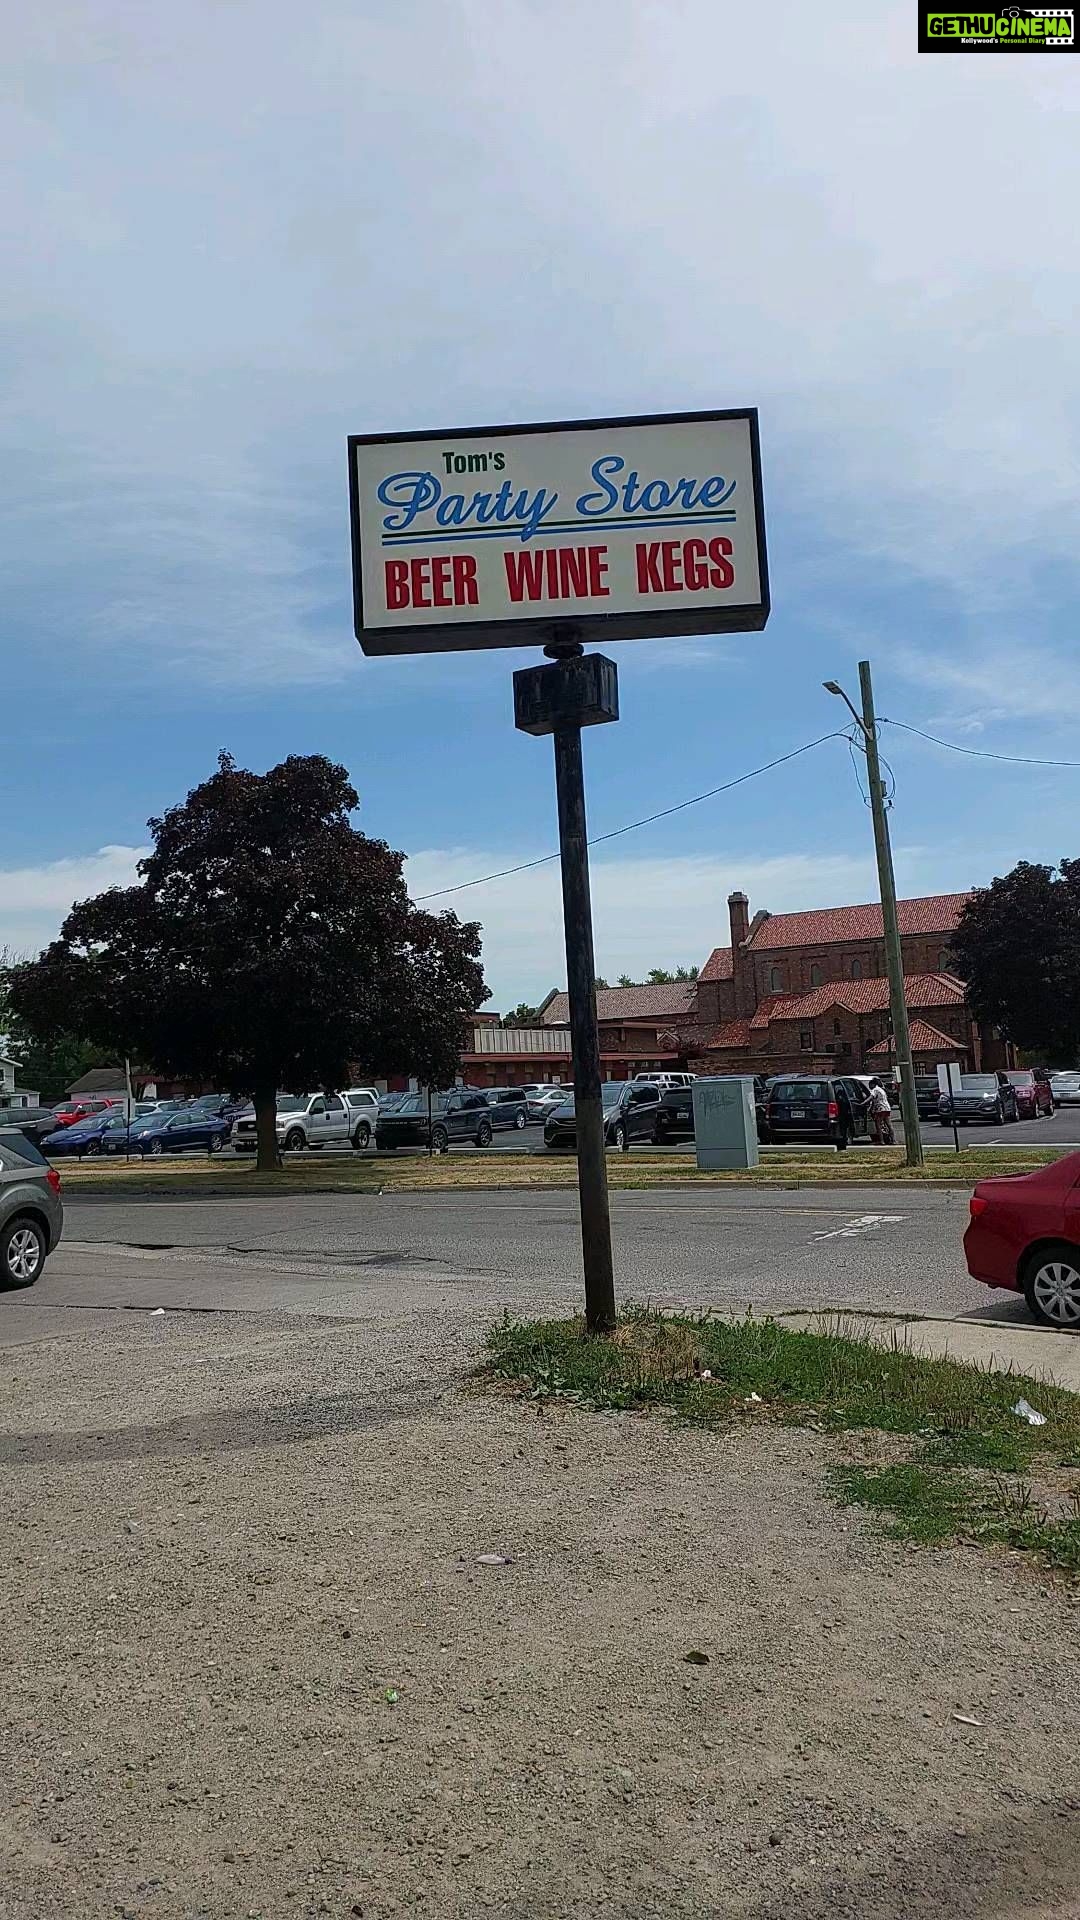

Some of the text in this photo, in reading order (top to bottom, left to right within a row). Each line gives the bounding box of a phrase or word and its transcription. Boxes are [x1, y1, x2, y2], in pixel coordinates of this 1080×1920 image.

[377, 456, 737, 542] Party Store
[442, 452, 505, 474] Tom's
[385, 537, 735, 609] BEER WINE KEGS
